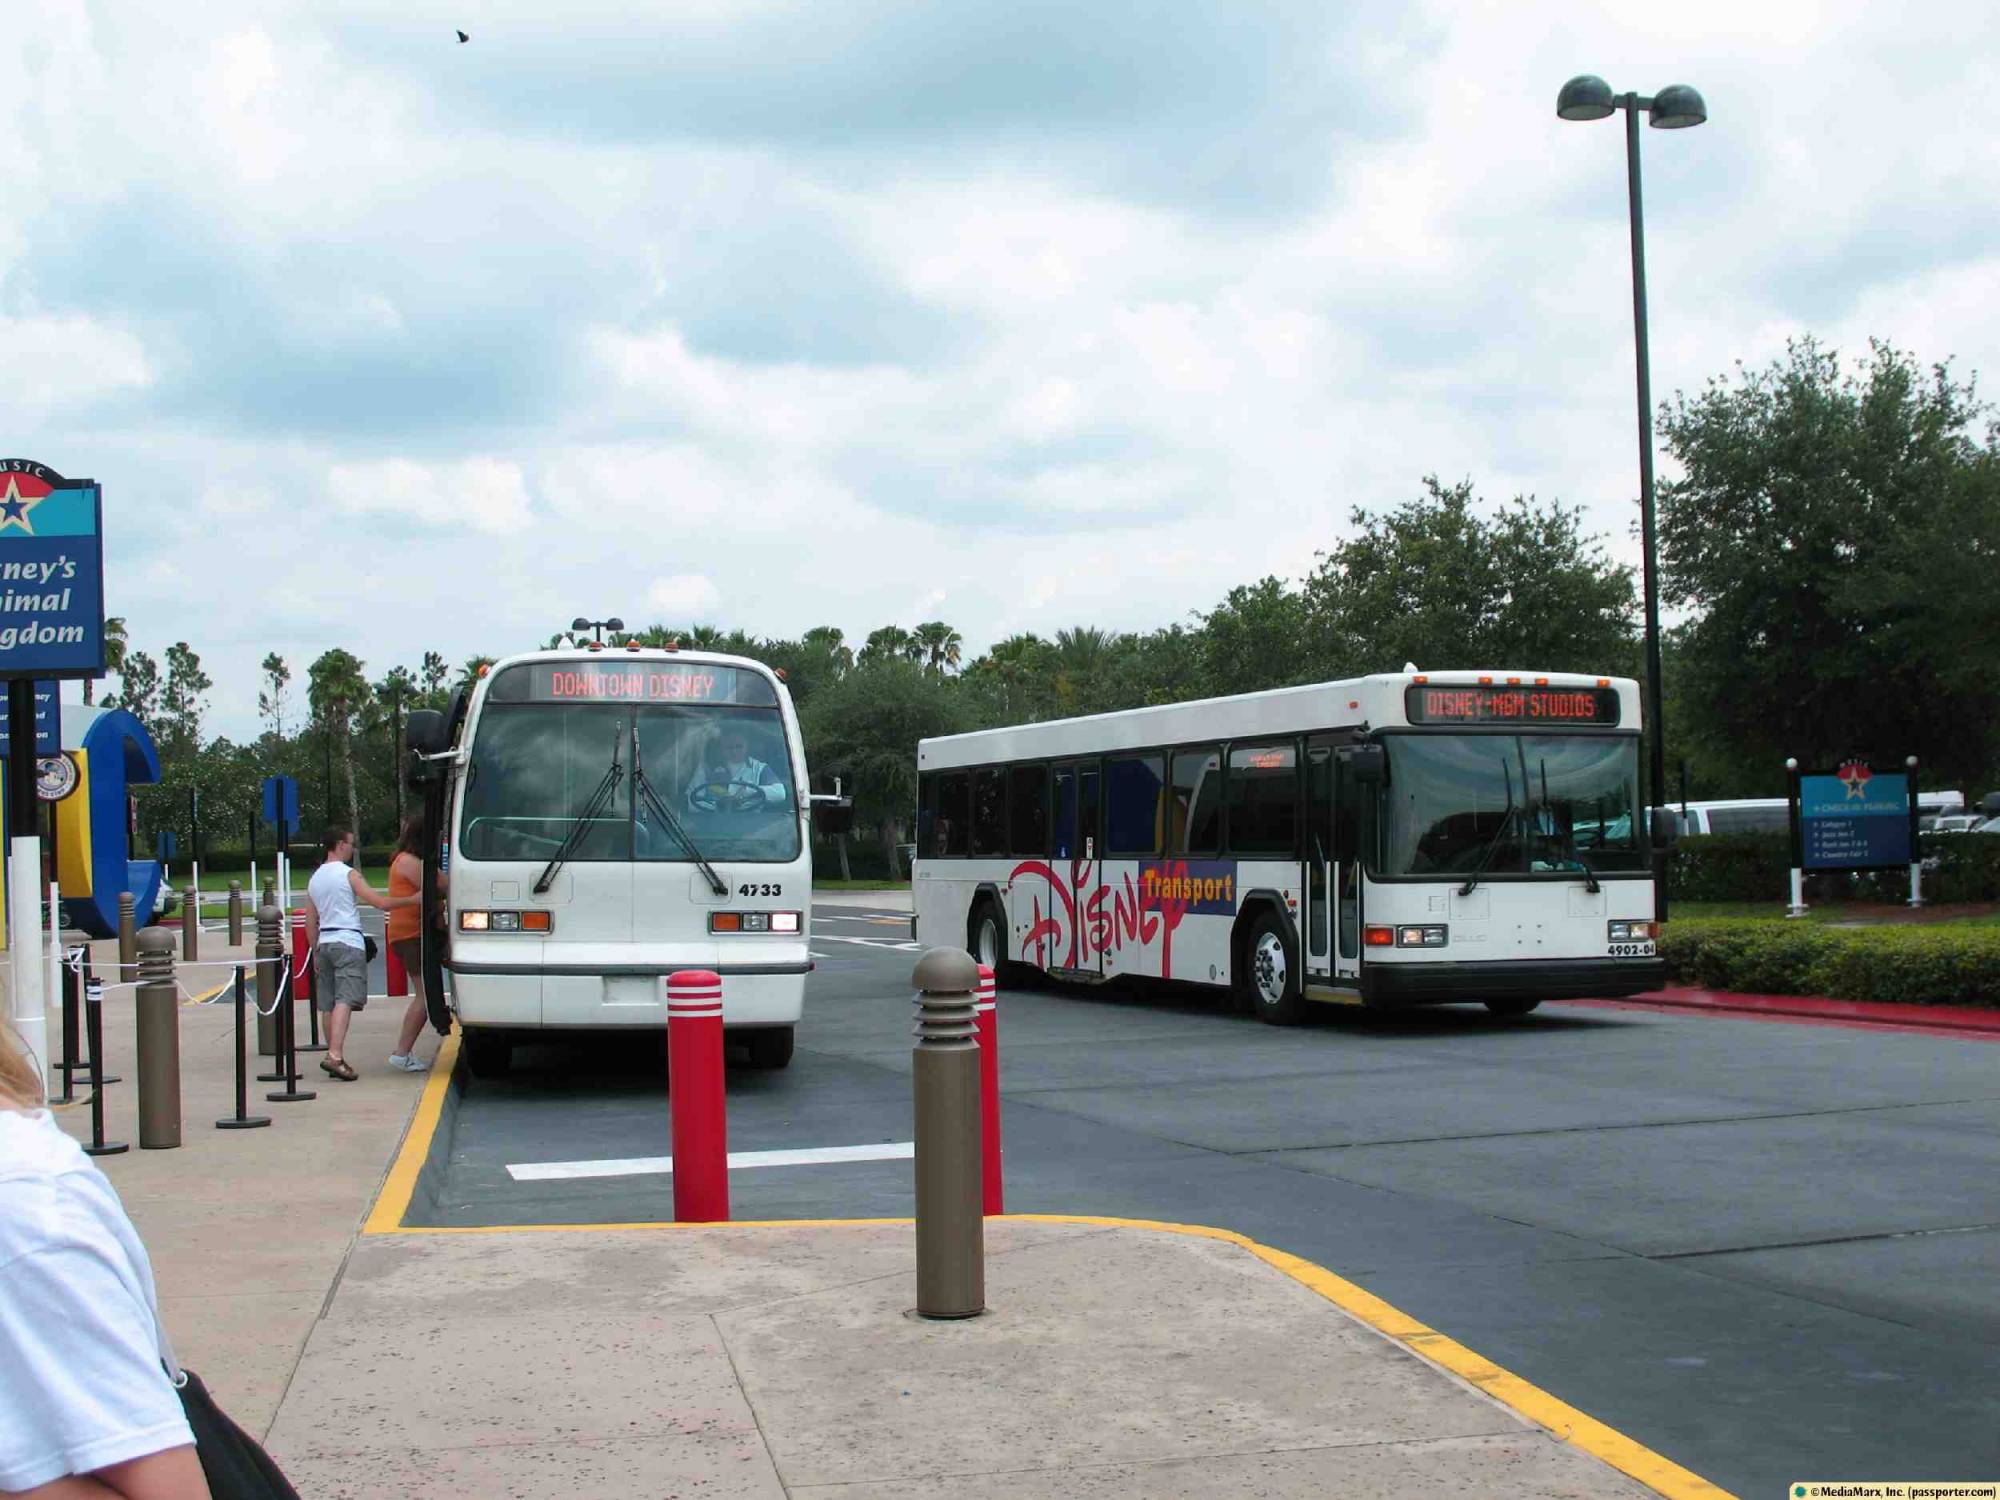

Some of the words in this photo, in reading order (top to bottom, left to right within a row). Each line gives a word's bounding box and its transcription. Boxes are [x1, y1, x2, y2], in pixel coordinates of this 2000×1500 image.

[0, 461, 45, 478] USIC
[0, 555, 76, 584] ney's
[0, 621, 84, 650] gdom
[552, 672, 643, 698] DOWNTOWN
[650, 674, 714, 698] DISNEY
[1427, 691, 1525, 717] DISNEY-MGM
[1531, 694, 1595, 717] STUDIOS
[739, 884, 782, 897] 4733
[1144, 869, 1232, 906] Transport
